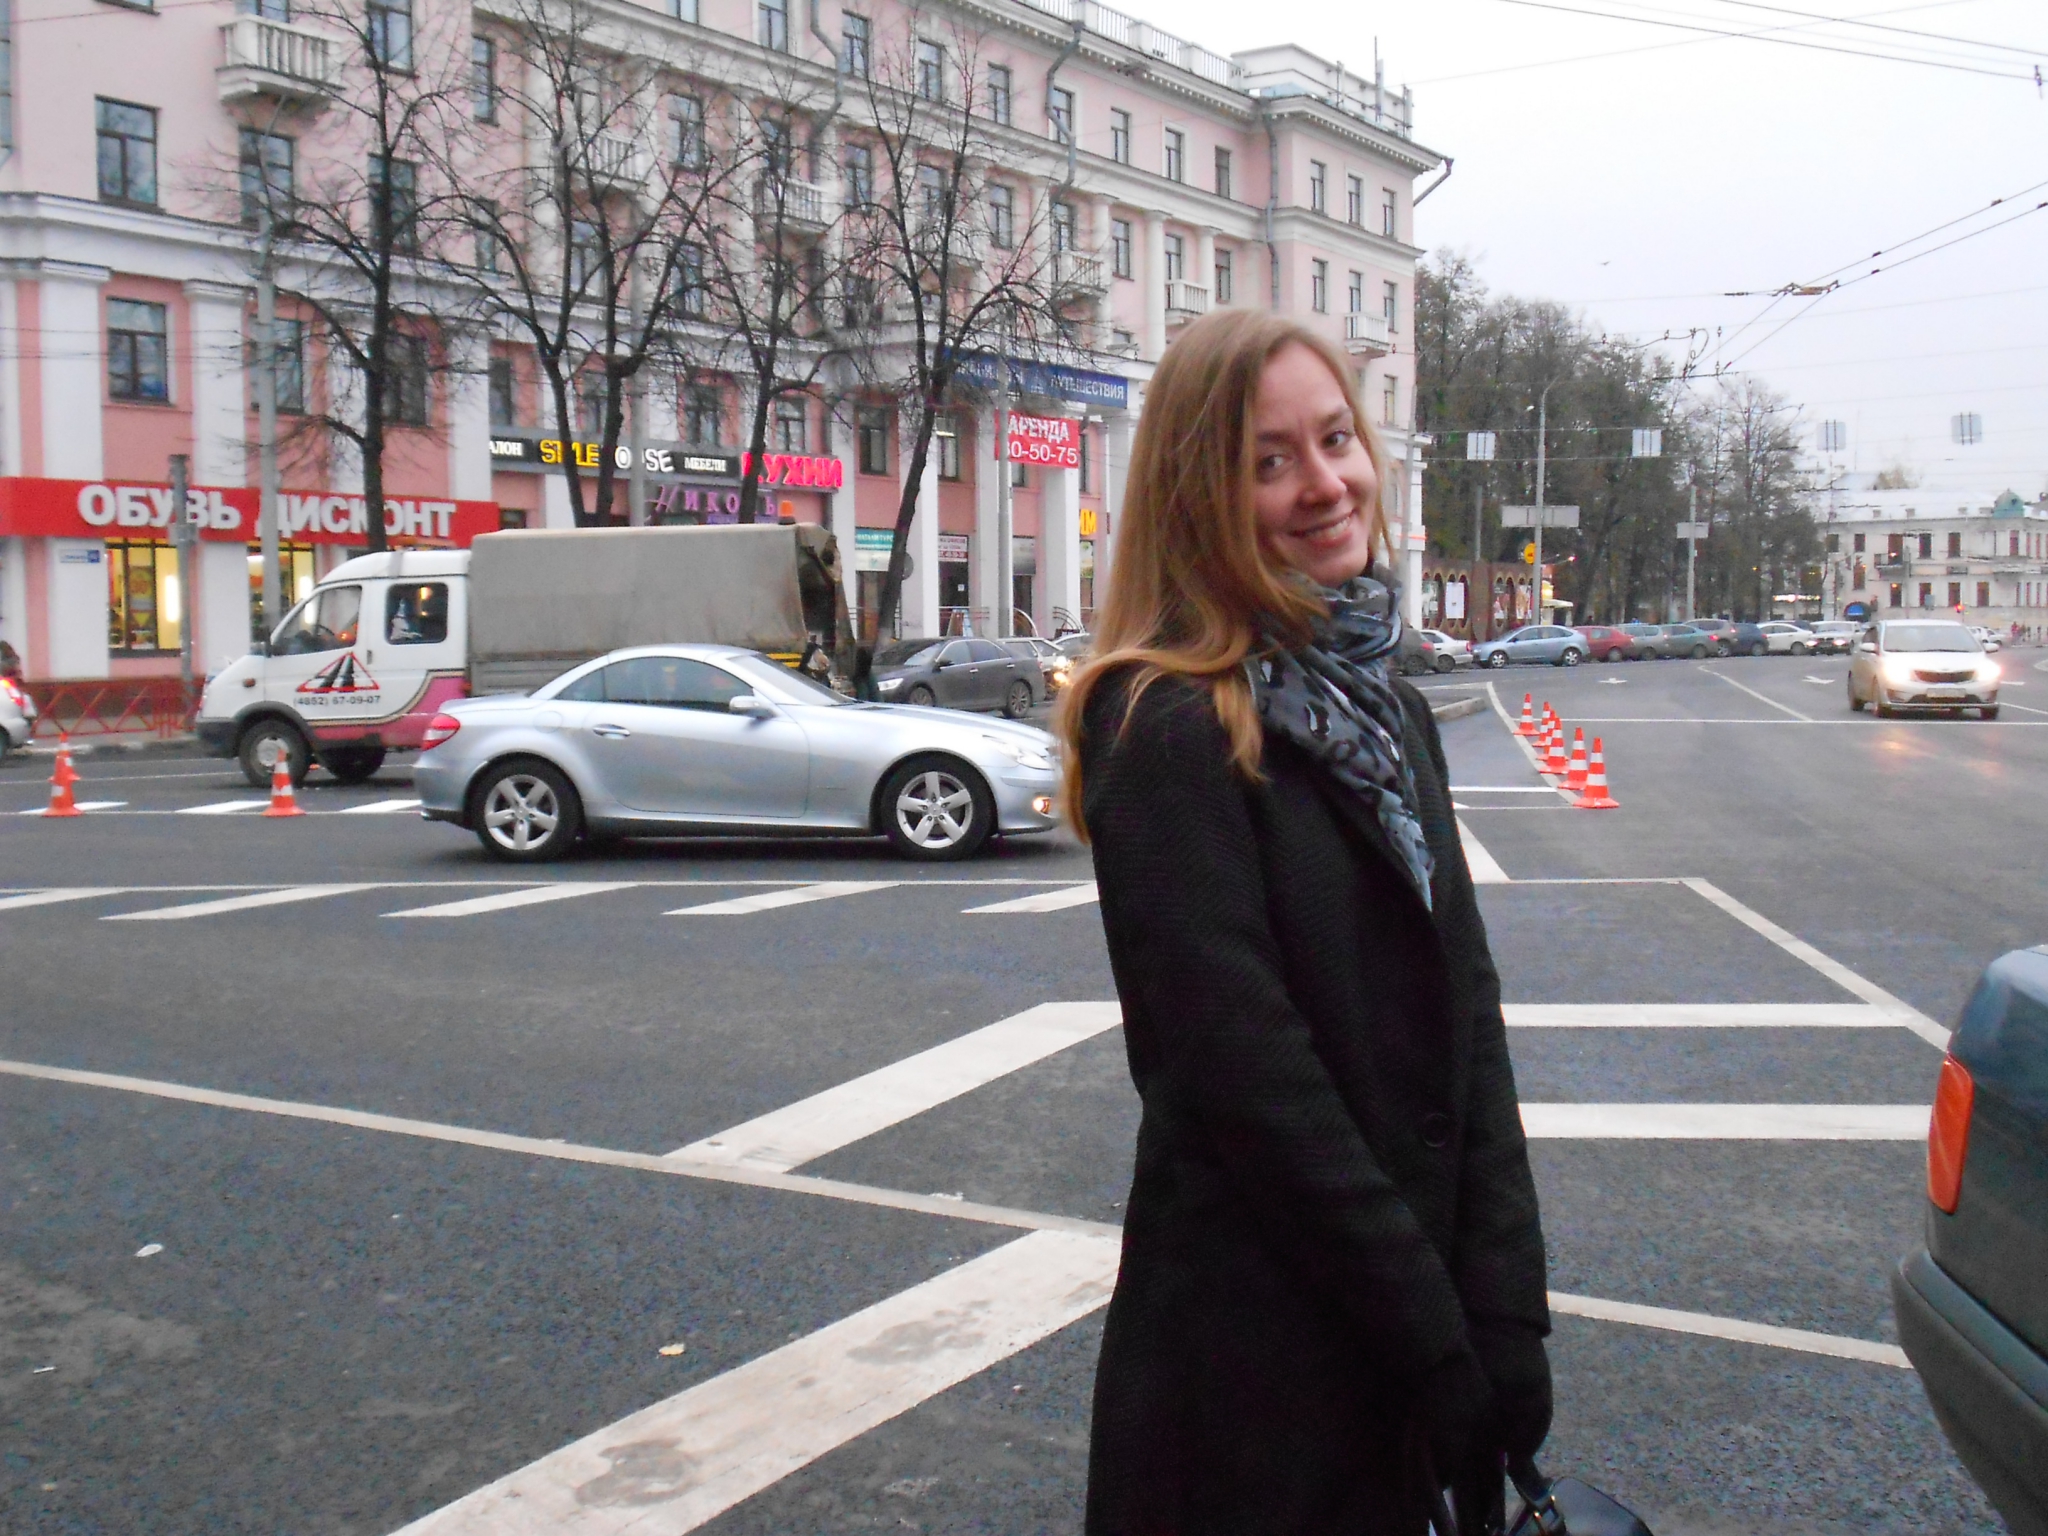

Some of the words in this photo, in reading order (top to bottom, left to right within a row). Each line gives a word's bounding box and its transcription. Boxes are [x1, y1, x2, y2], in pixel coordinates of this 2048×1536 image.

[1007, 414, 1070, 444] АРЕНДА
[488, 440, 524, 457] АЛОН
[684, 456, 727, 472] МЕБЕЛИ
[77, 484, 242, 531] ОБУВЬ
[332, 695, 381, 705] 67-09-07
